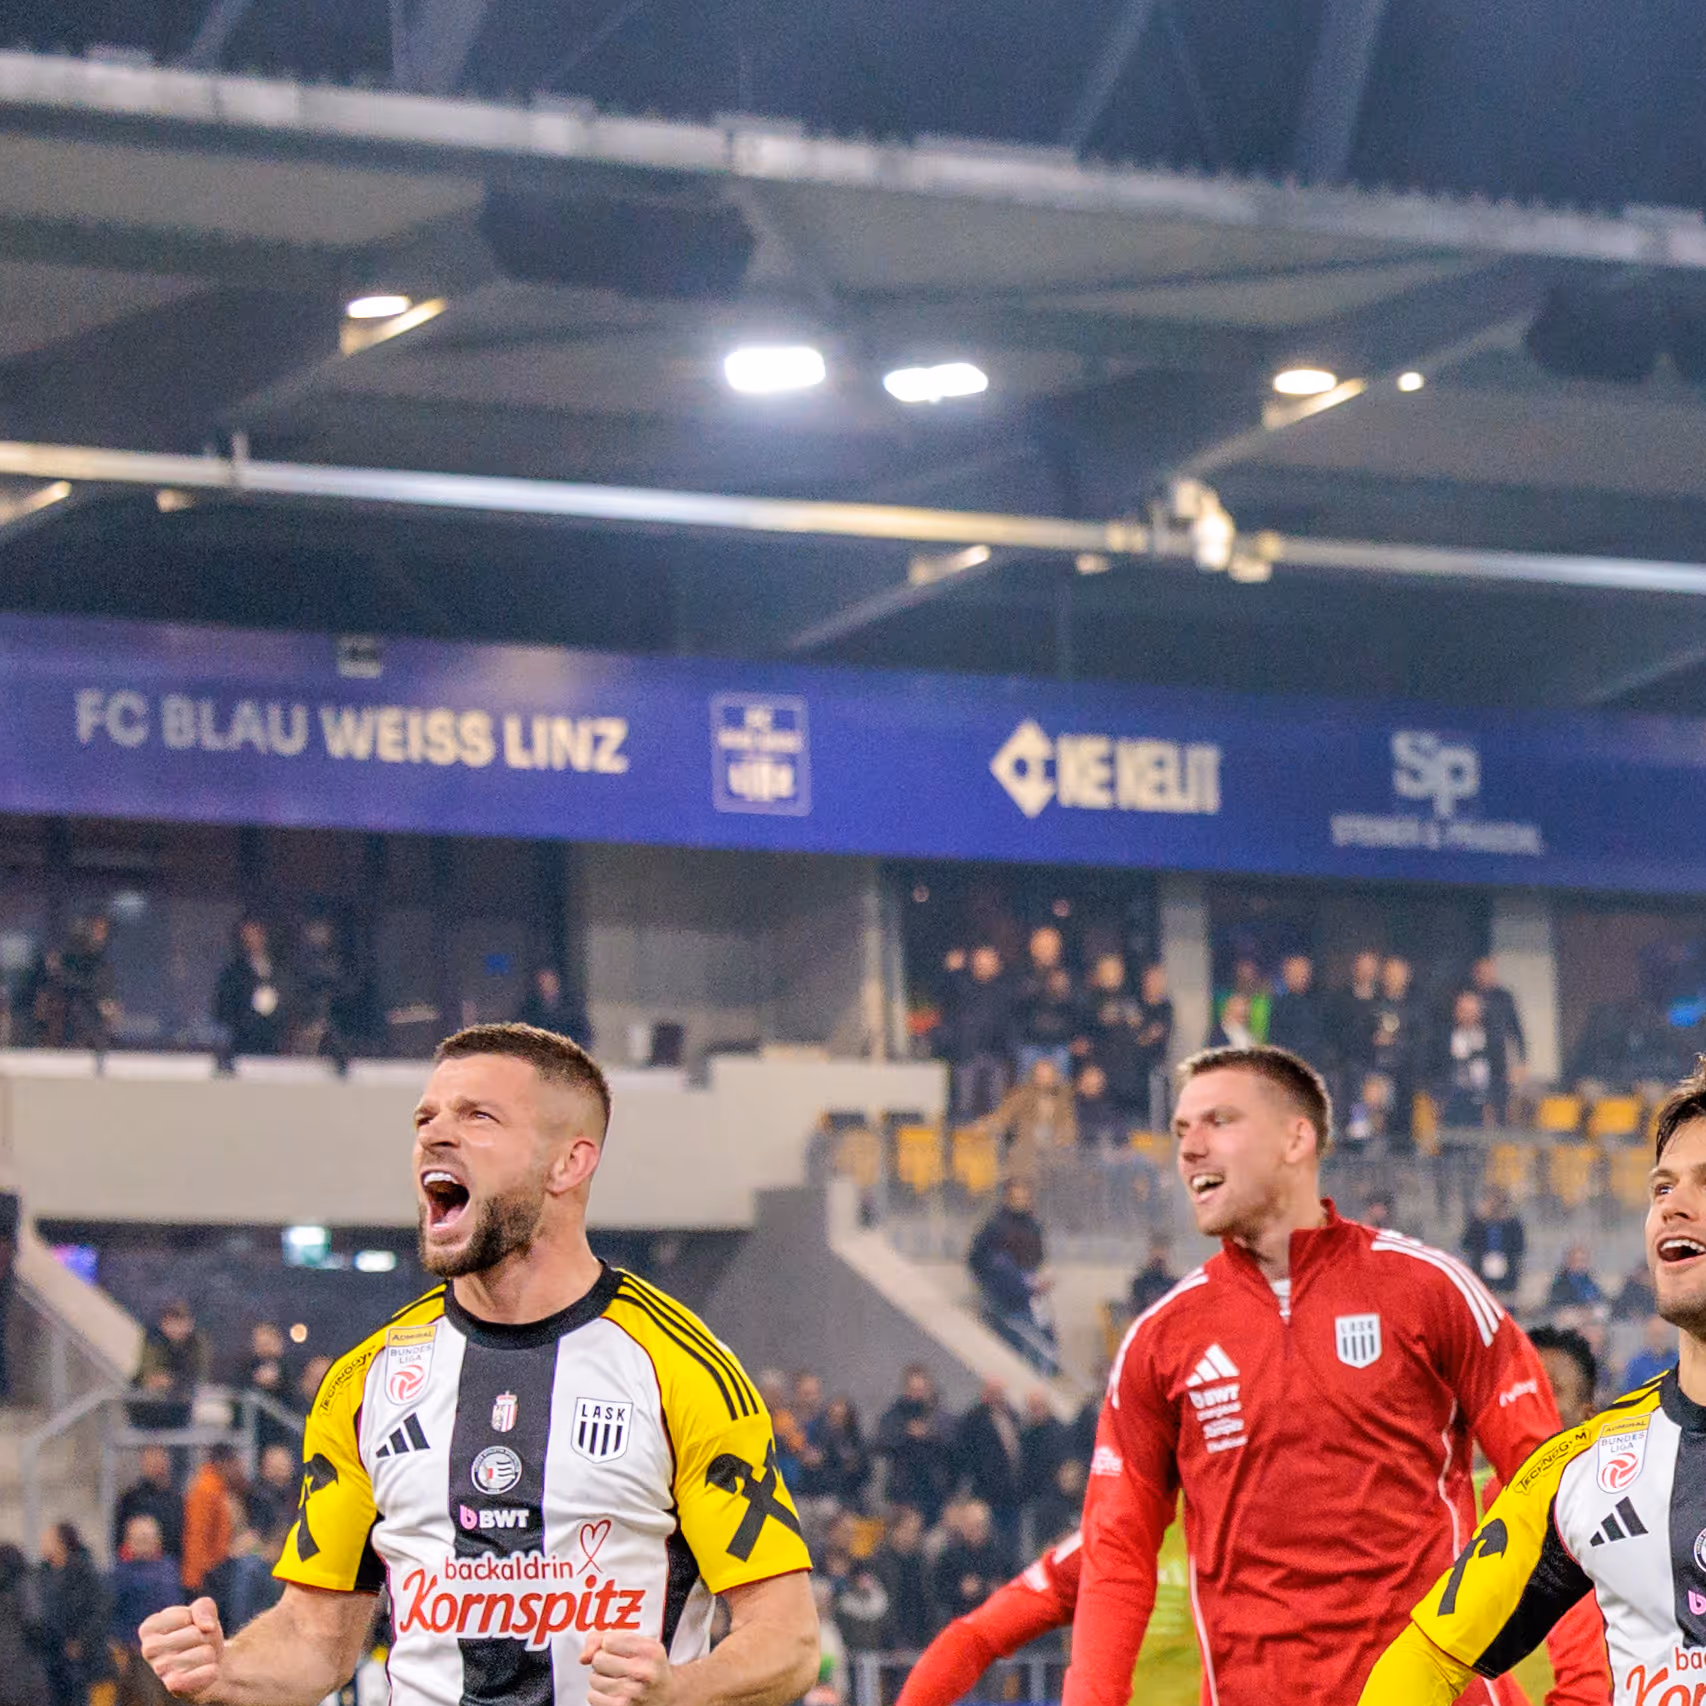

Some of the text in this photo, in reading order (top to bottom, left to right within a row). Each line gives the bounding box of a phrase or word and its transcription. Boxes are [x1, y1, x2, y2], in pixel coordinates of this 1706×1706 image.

[76, 688, 629, 774] FC BLAU WEISS LINZ
[581, 1403, 627, 1421] LASK
[1601, 1433, 1645, 1447] BUNDES
[1610, 1442, 1634, 1453] LIGA
[479, 1509, 529, 1529] BWT
[444, 1556, 573, 1580] backaldrin
[399, 1569, 646, 1645] Kornspitz
